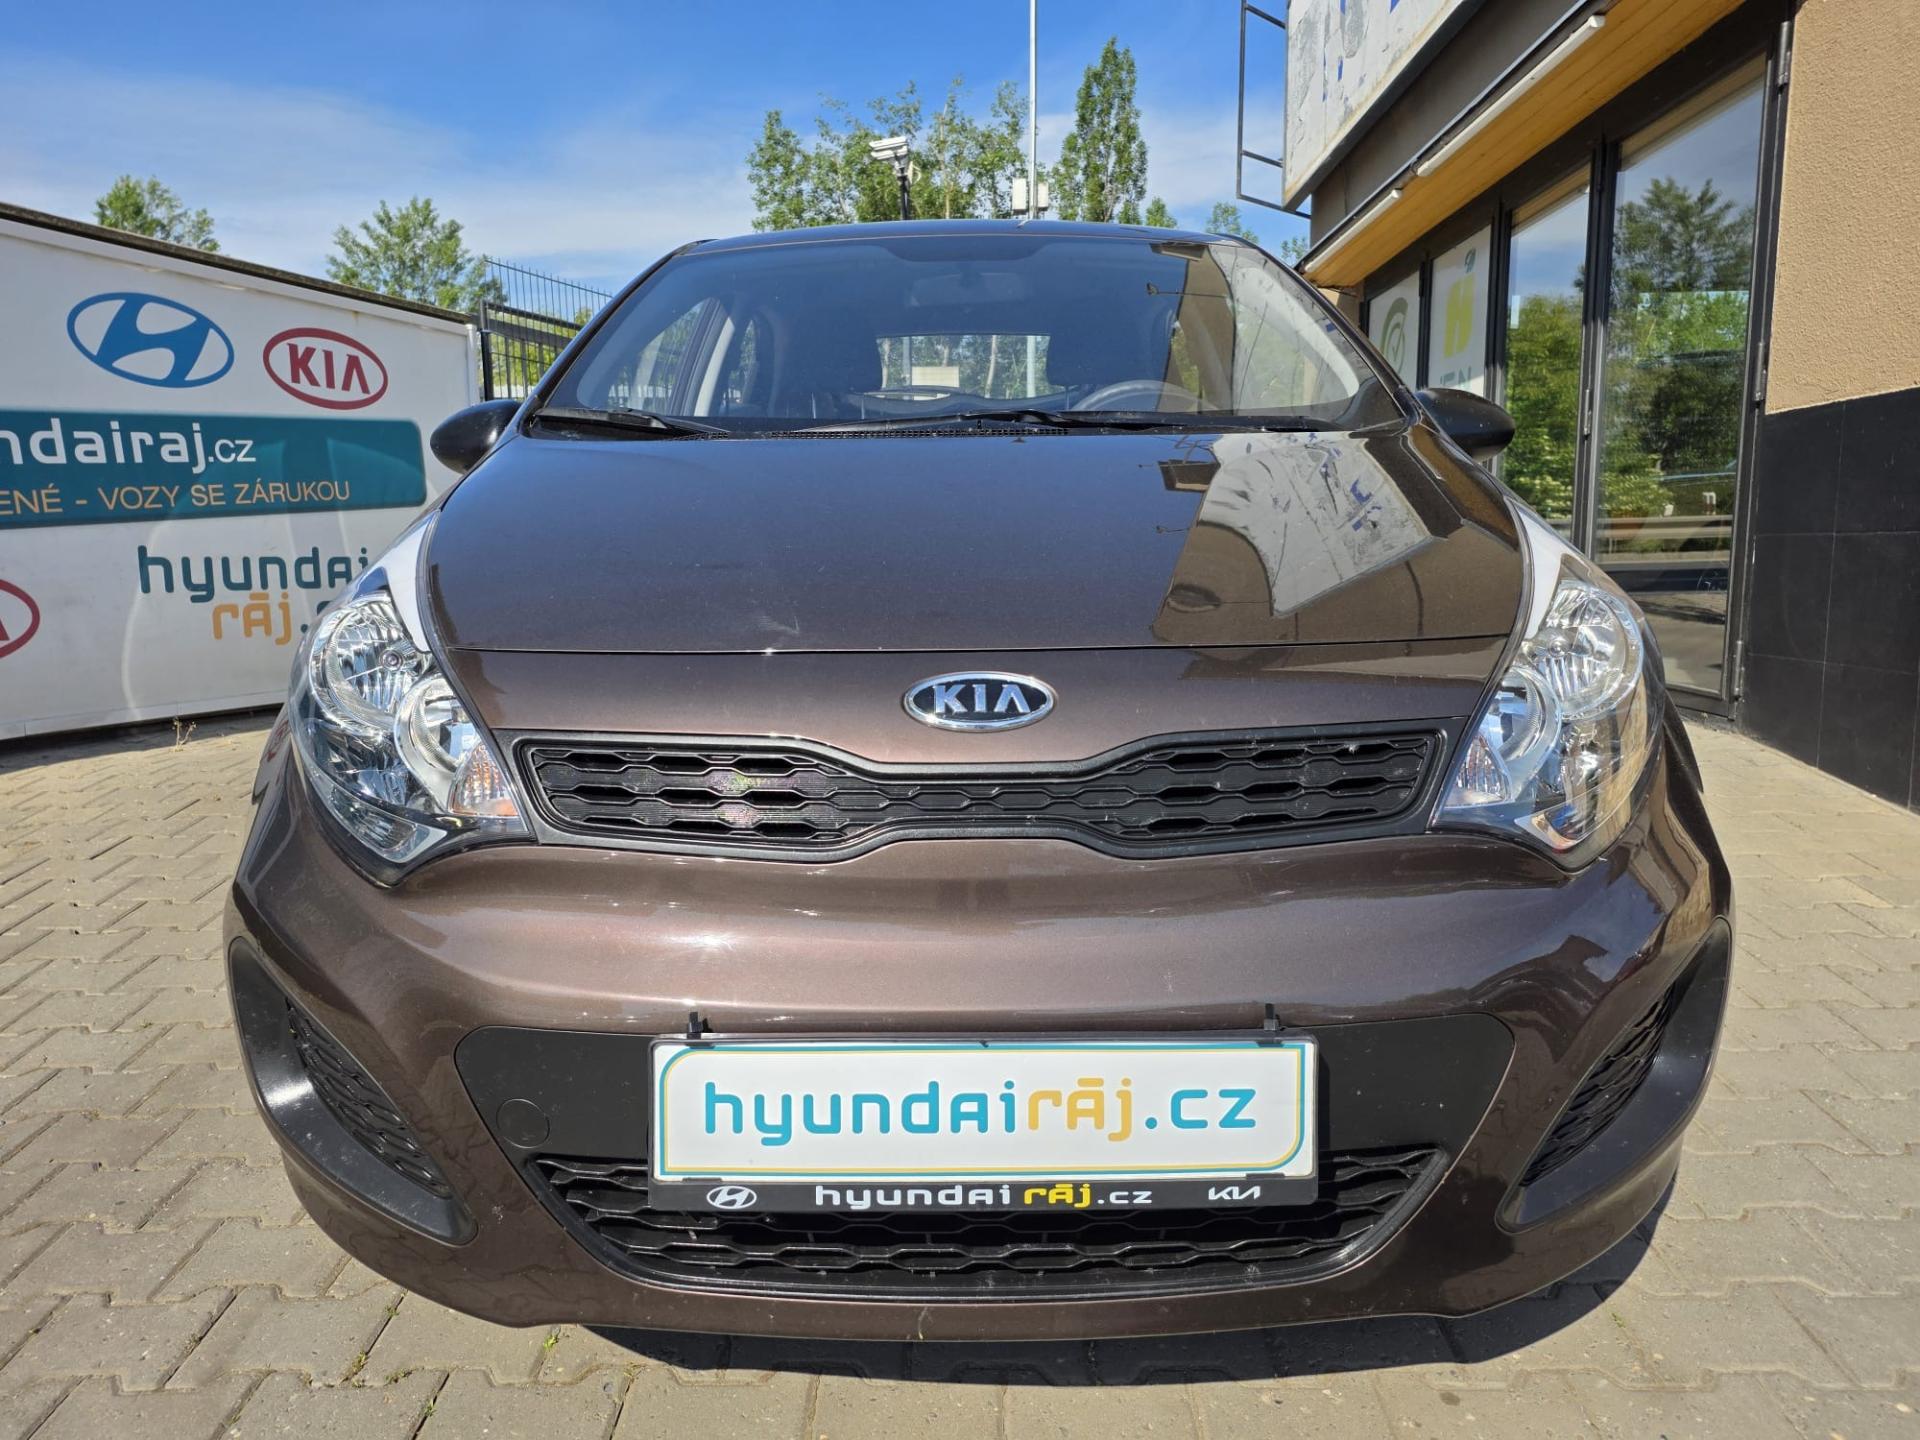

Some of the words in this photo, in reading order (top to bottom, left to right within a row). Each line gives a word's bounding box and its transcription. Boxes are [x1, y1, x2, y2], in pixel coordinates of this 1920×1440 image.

[286, 342, 371, 395] KIA
[97, 485, 180, 511] VOZY
[190, 483, 227, 507] SE
[233, 477, 351, 505] ZÁRUKOU
[932, 683, 1031, 714] KIA
